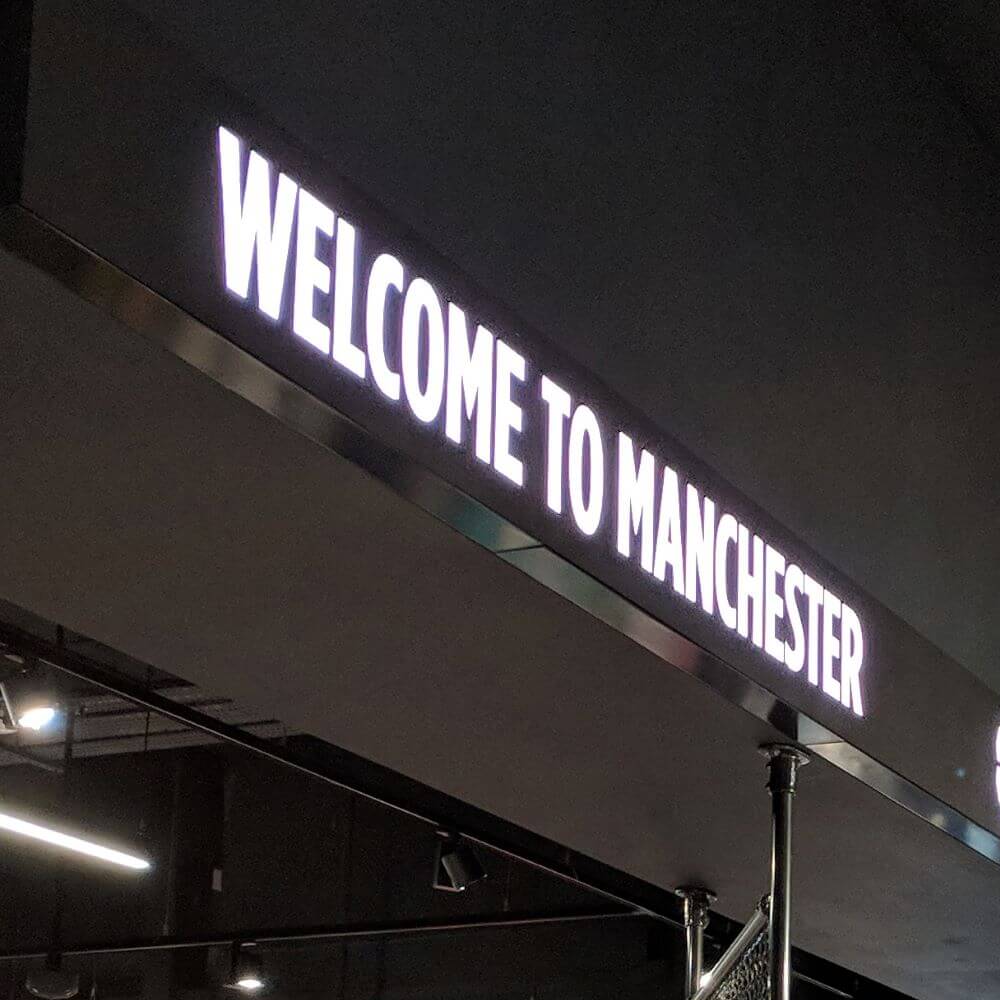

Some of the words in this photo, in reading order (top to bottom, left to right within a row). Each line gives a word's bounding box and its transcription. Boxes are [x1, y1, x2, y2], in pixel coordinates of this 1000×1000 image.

[217, 125, 526, 488] WELCOME
[540, 372, 605, 536] TO
[617, 431, 866, 718] MANCHESTER
